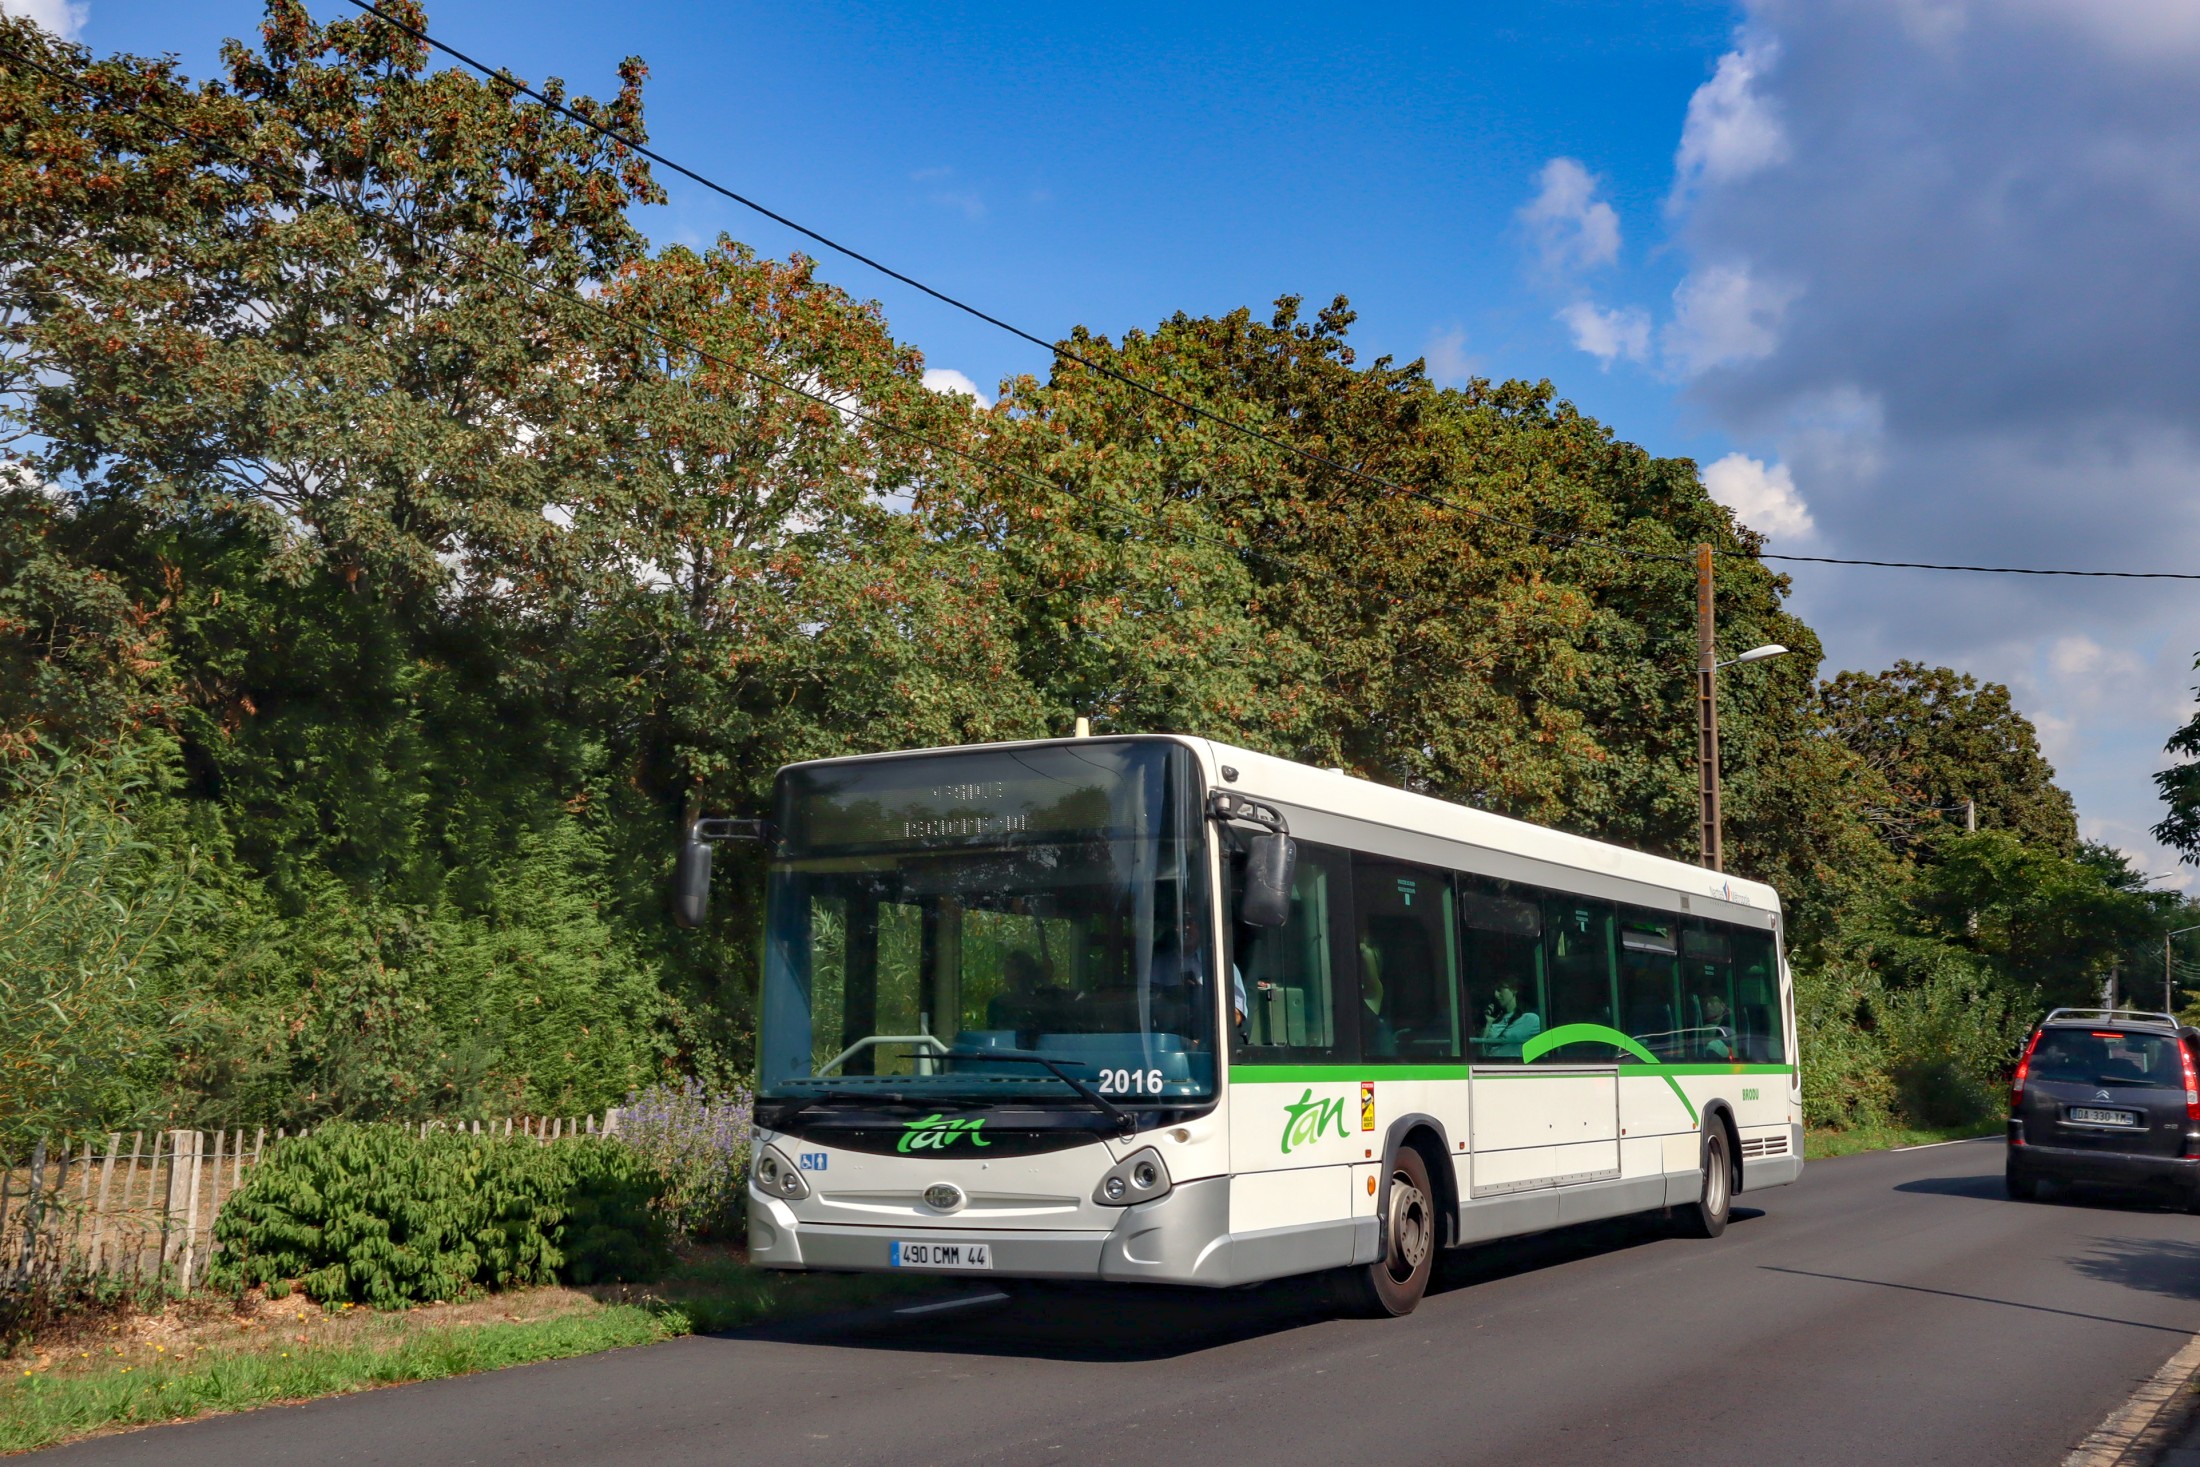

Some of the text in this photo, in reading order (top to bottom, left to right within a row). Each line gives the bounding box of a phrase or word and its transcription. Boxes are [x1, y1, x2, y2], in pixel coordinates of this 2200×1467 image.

[1099, 1069, 1163, 1094] 2016
[897, 1113, 991, 1152] tan
[1281, 1088, 1350, 1154] tan
[903, 1245, 985, 1265] 490 CMM 44
